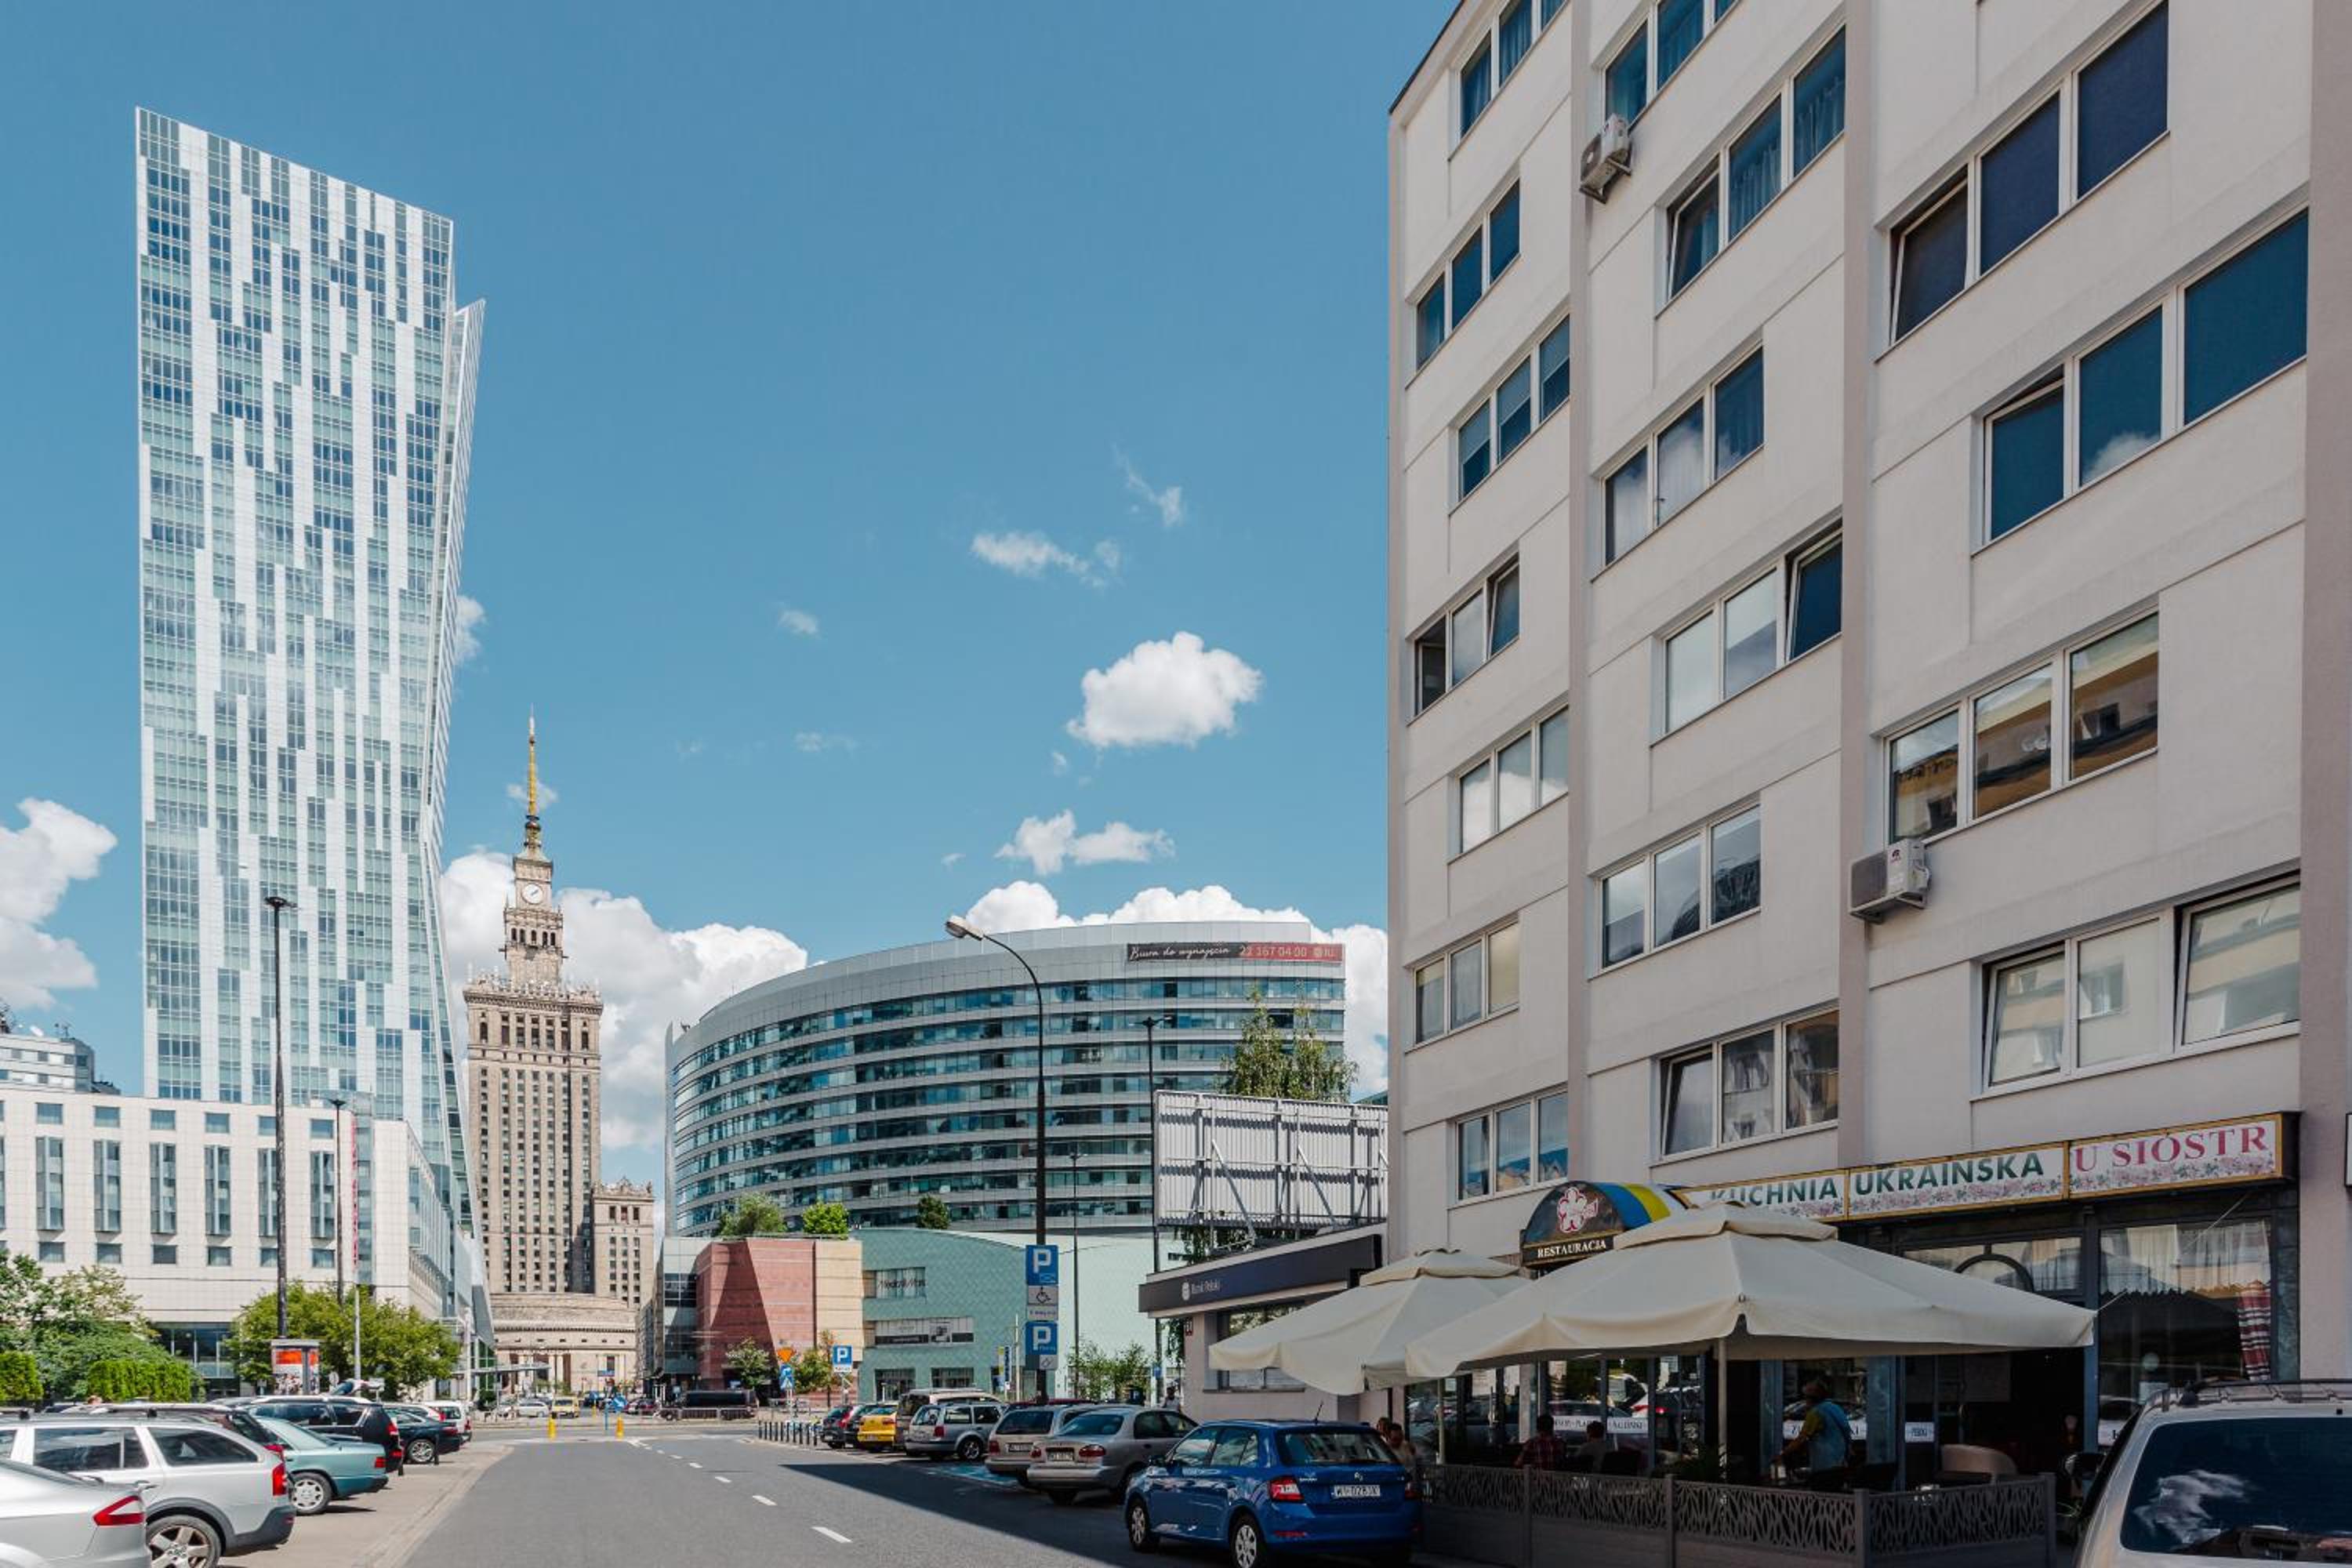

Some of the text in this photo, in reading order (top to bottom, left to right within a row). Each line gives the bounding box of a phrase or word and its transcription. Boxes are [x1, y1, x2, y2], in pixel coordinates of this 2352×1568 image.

[2075, 1145, 2097, 1171] U
[2112, 1127, 2268, 1167] SIÓSTR
[1537, 1240, 1606, 1258] RESTAURACJA
